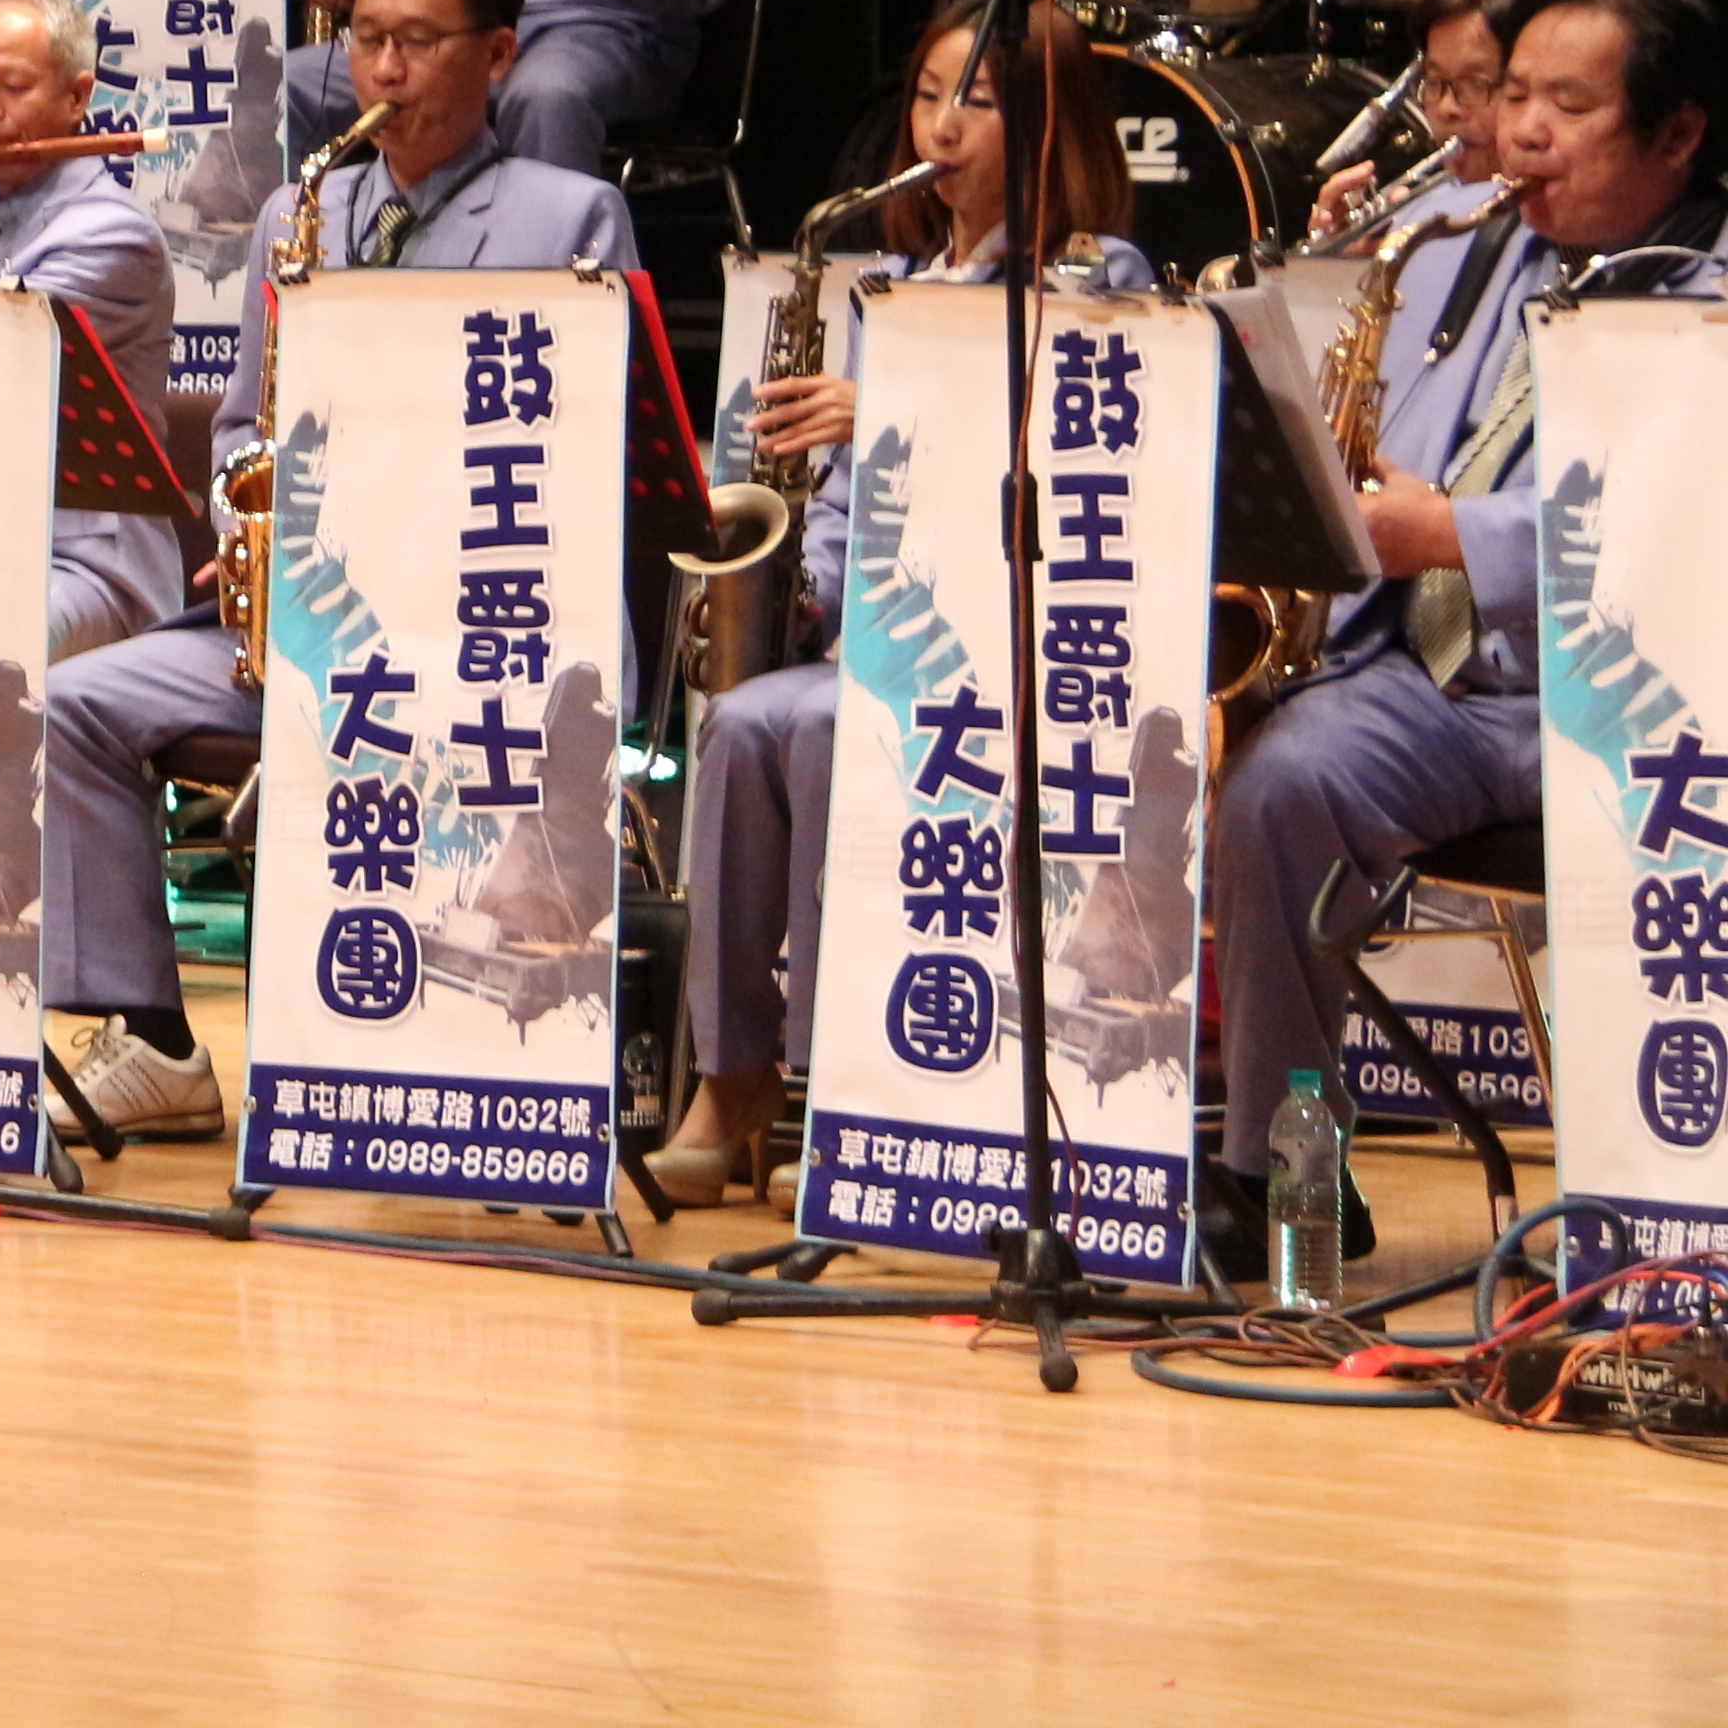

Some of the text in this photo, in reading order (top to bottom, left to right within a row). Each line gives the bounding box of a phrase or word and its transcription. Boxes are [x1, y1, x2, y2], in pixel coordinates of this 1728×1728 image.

[450, 310, 554, 808] 鼓王爵士
[1041, 330, 1144, 858] 鼓王爵士
[316, 654, 419, 1021] 大樂團
[885, 686, 1007, 1073] 大樂團
[1630, 731, 1728, 1147] 大樂團
[268, 1127, 591, 1186] 電話：0989-859666
[273, 1078, 591, 1138] 草屯鎮博愛路1032號
